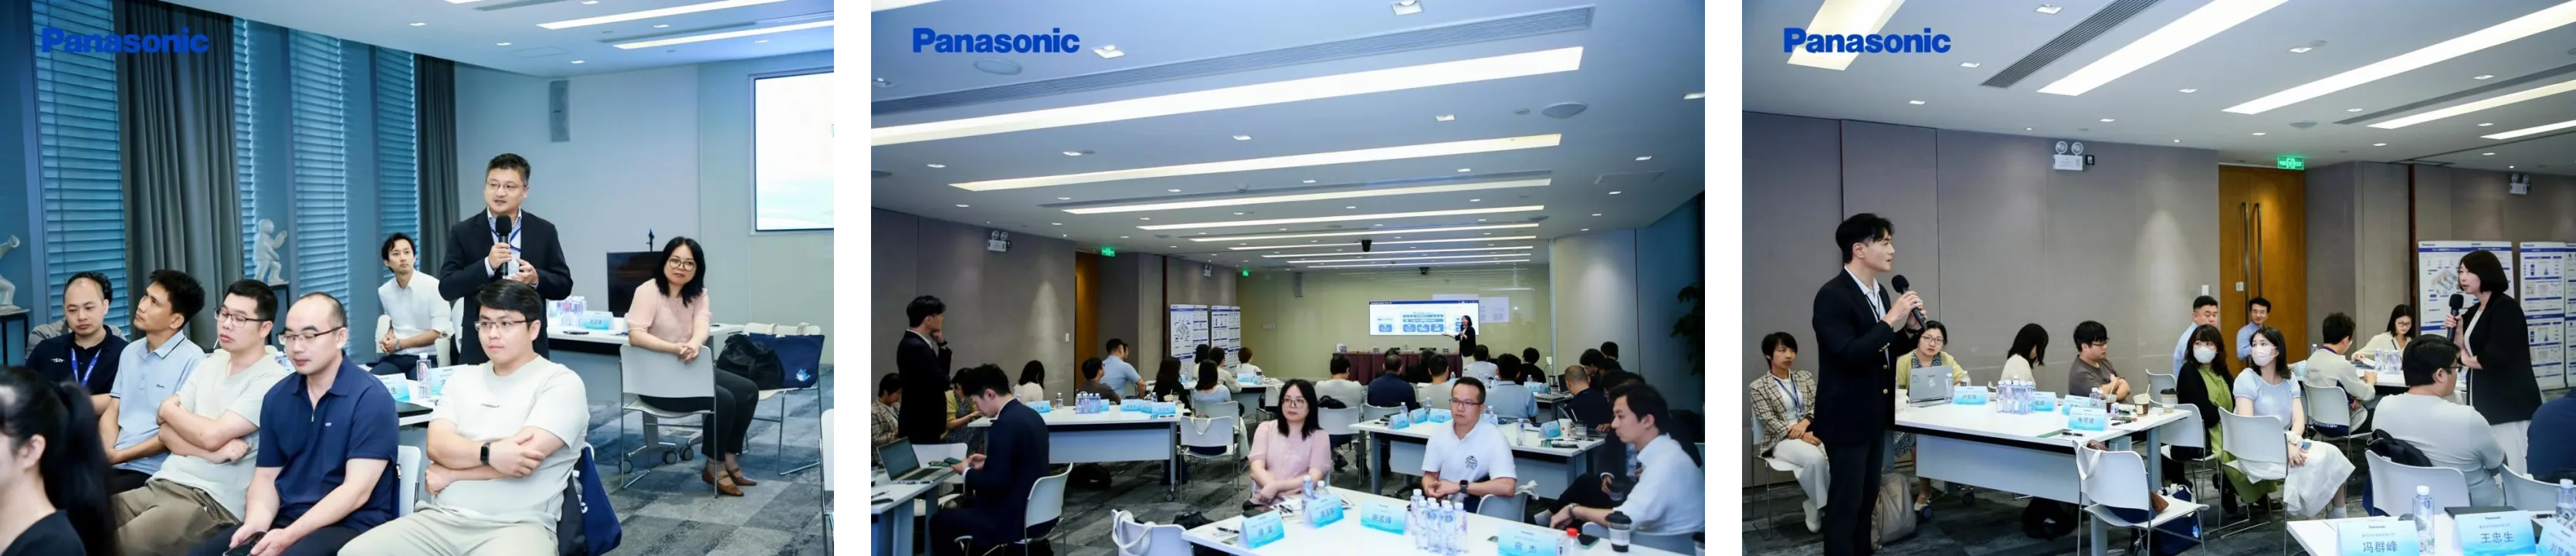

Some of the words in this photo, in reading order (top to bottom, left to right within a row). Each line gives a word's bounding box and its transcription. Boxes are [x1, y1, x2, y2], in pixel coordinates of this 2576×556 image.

[2480, 531, 2514, 544] 王忠生
[2363, 541, 2398, 553] 冯群峰
